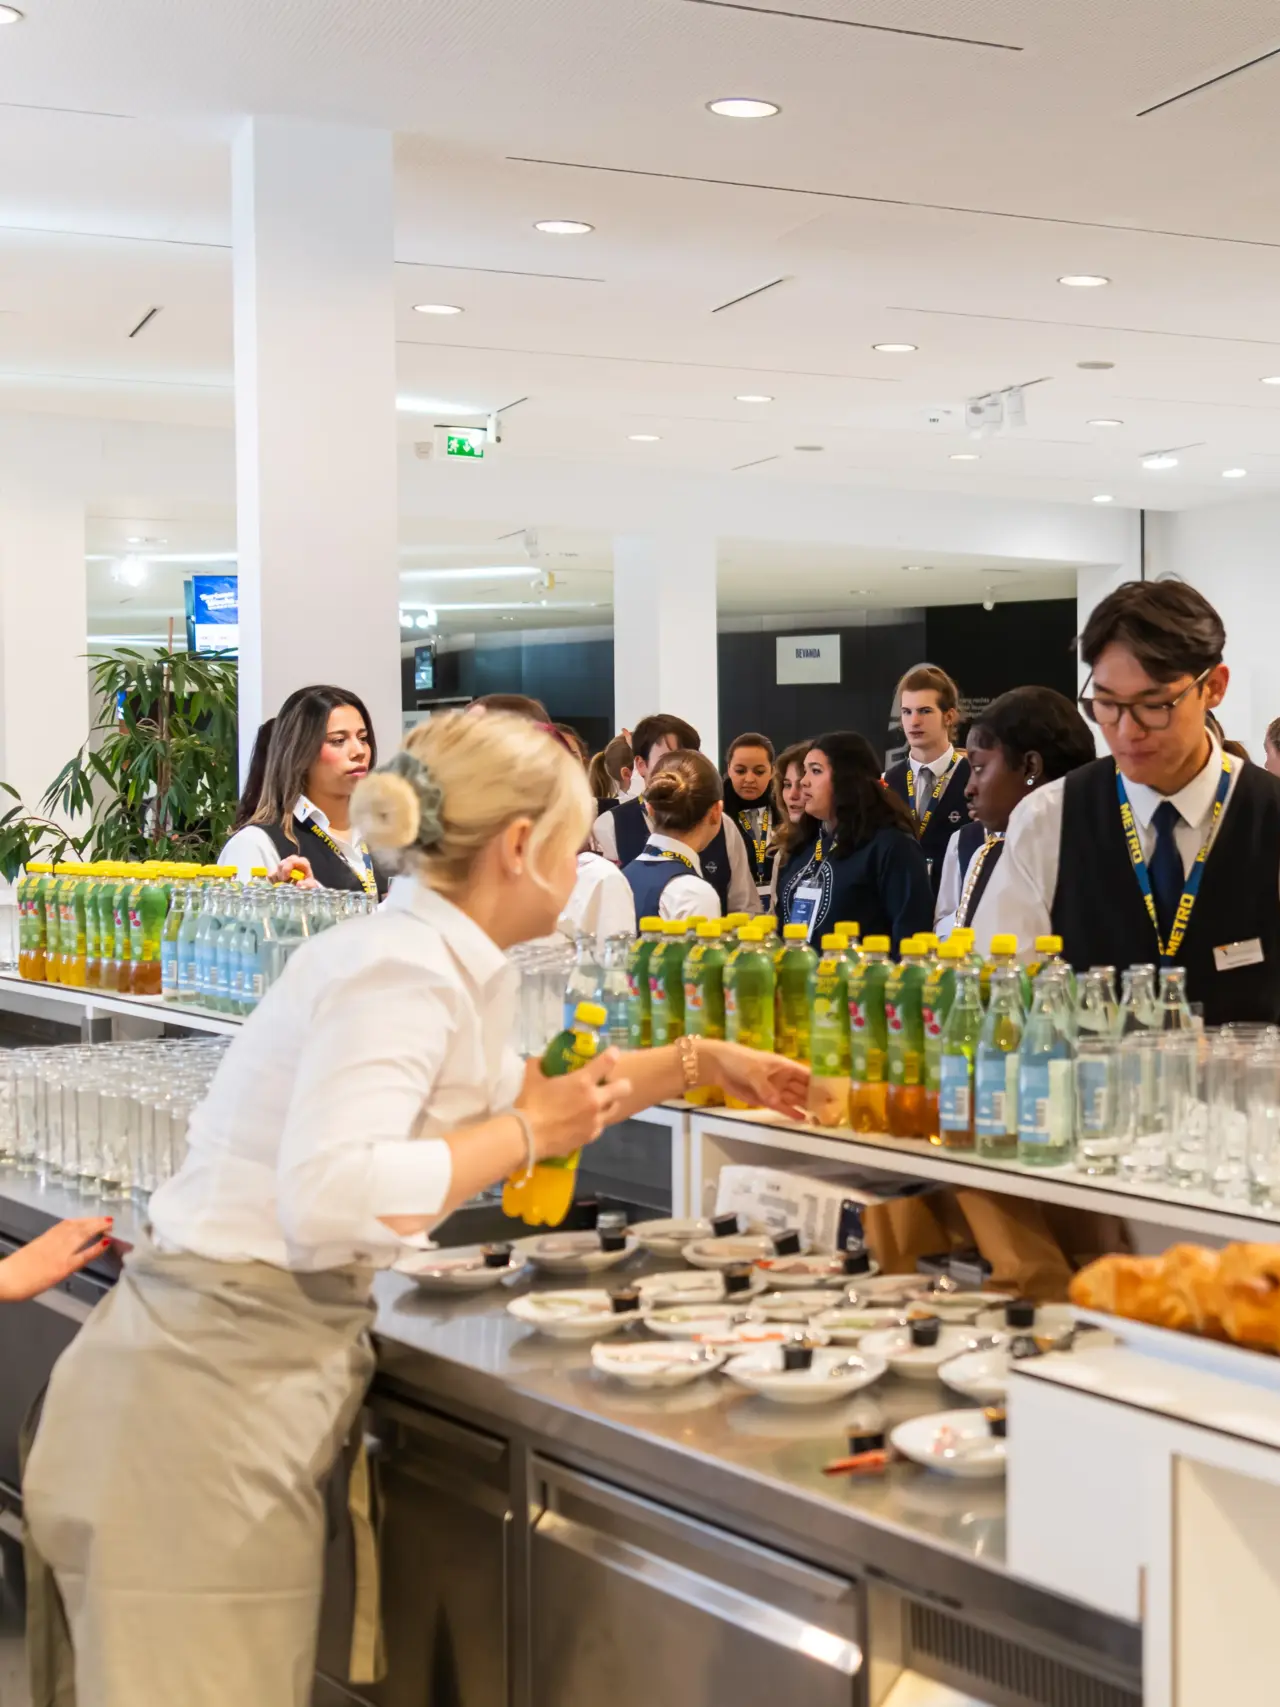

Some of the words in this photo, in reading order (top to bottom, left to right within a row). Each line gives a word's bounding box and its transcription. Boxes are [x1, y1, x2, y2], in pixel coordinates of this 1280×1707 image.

[758, 839, 767, 864] METRO
[1119, 802, 1144, 864] METRO
[1165, 893, 1195, 957] METRO
